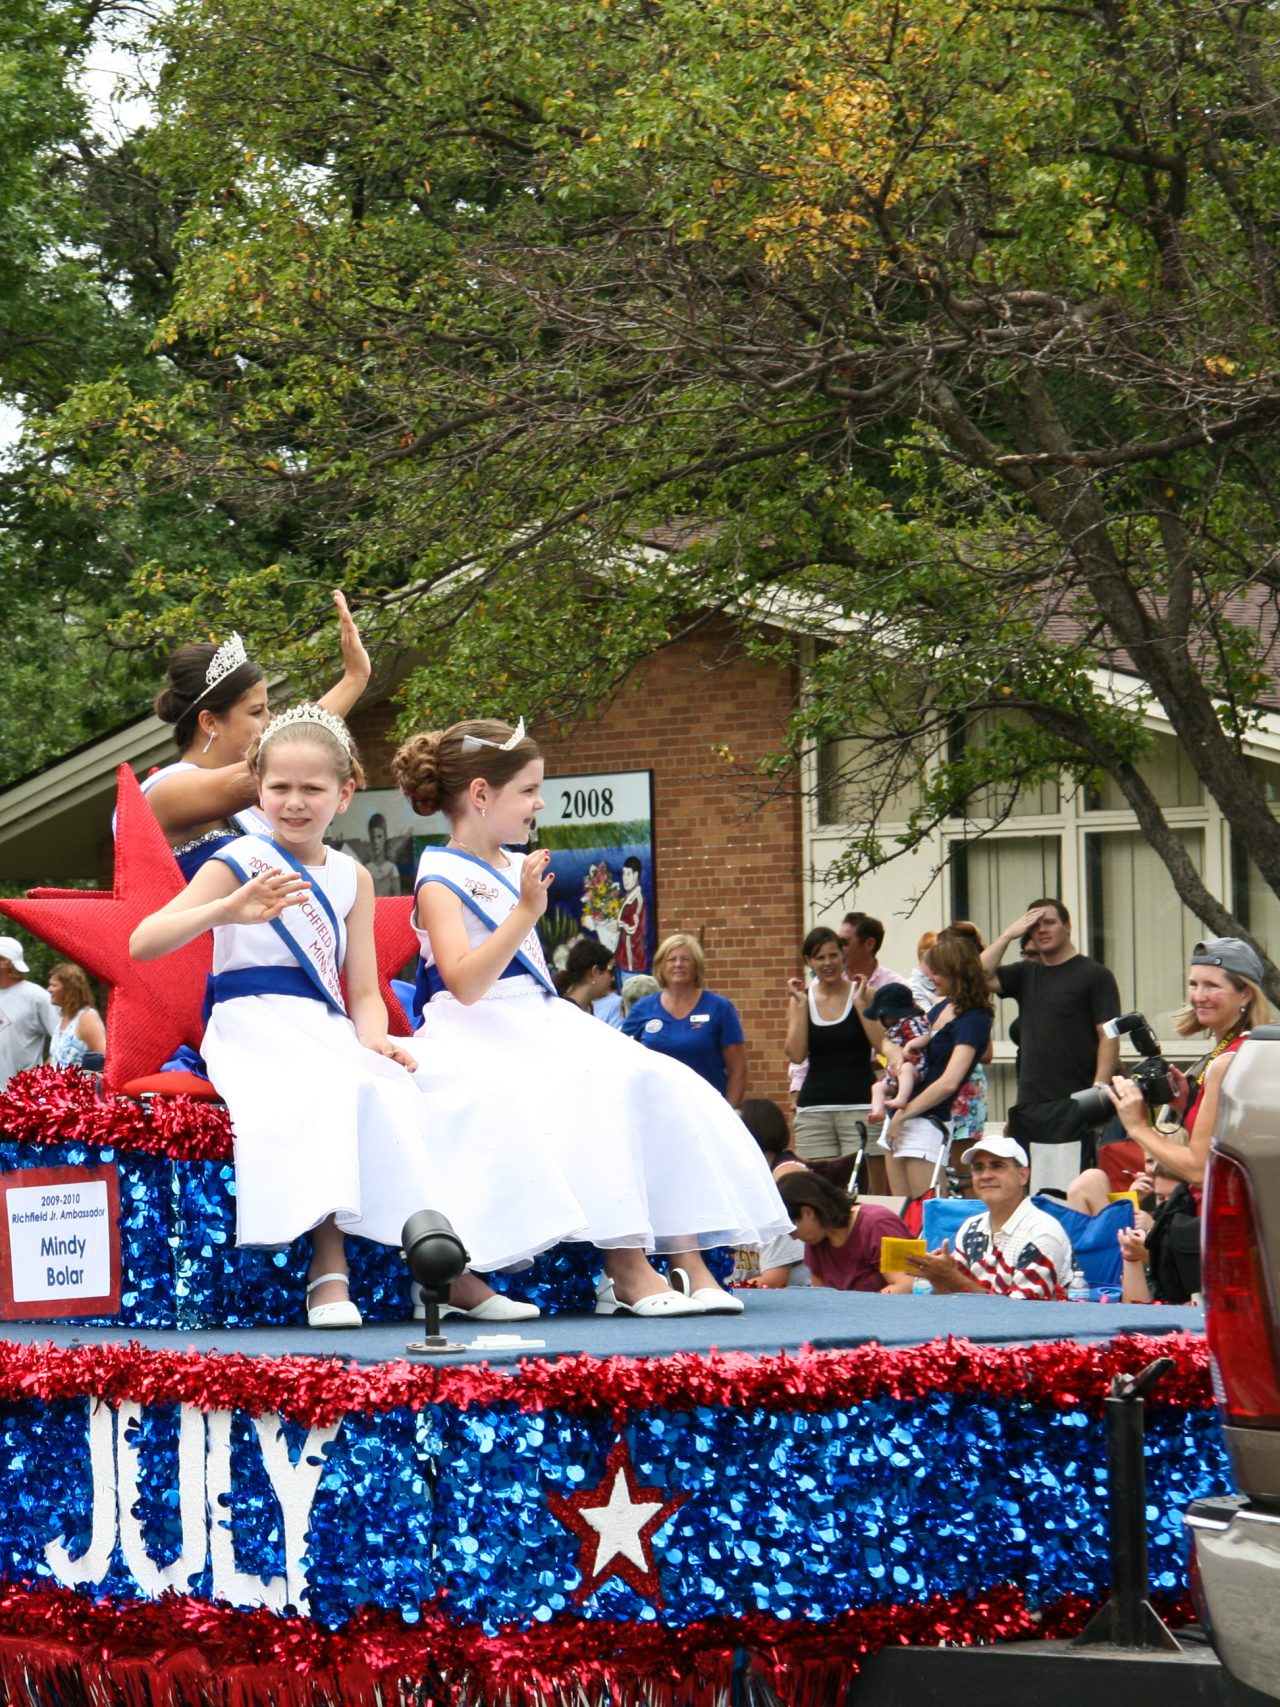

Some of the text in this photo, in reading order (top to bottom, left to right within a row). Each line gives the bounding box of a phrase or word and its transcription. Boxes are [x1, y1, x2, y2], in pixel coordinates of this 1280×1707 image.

[561, 788, 614, 819] 2008
[41, 1193, 81, 1207] 2009-2010
[12, 1207, 105, 1224] Richfield Jr. Ambassador
[40, 1234, 86, 1259] Mindy
[47, 1265, 84, 1287] Bolar
[44, 1397, 344, 1618] JULY
